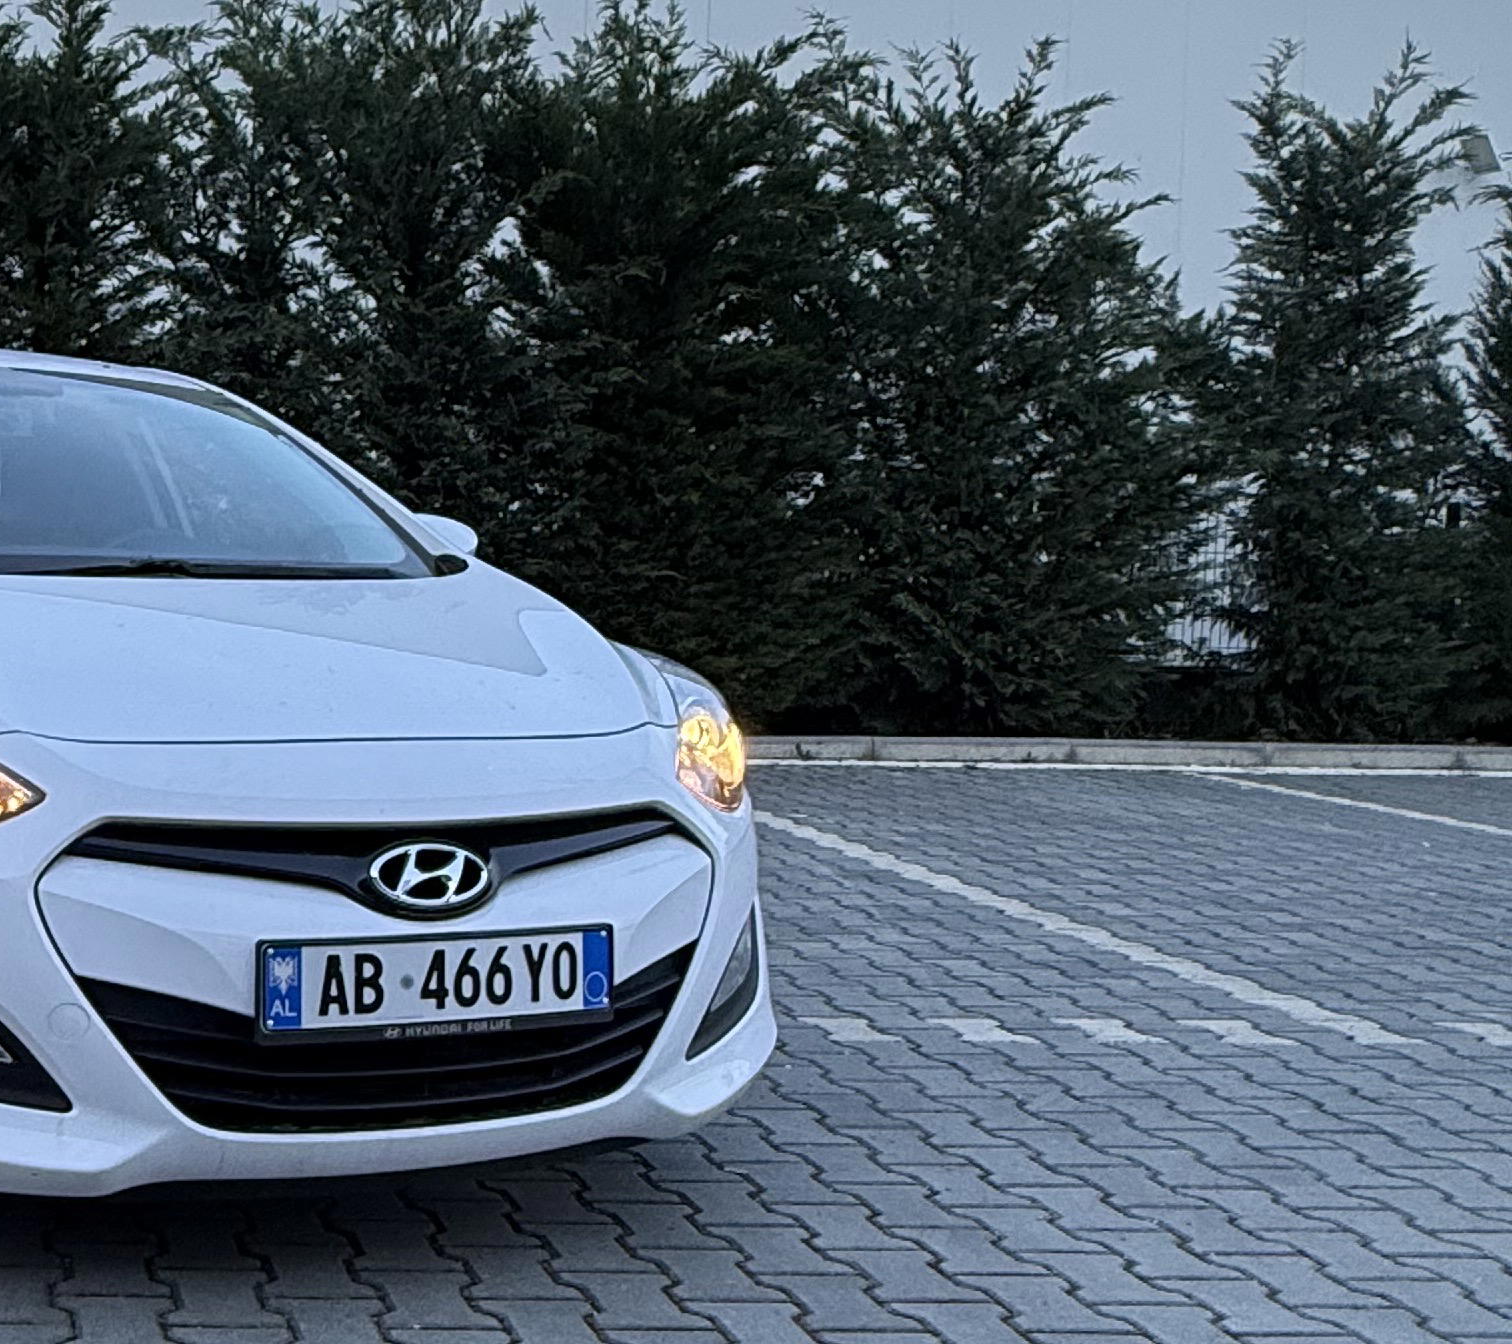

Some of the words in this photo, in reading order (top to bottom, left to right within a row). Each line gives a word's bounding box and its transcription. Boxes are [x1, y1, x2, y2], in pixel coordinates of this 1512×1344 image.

[318, 952, 384, 1016] AB
[270, 998, 298, 1017] AL
[405, 1023, 462, 1037] HYUNDAI
[466, 1021, 488, 1033] FOR
[489, 1018, 512, 1031] LIFE
